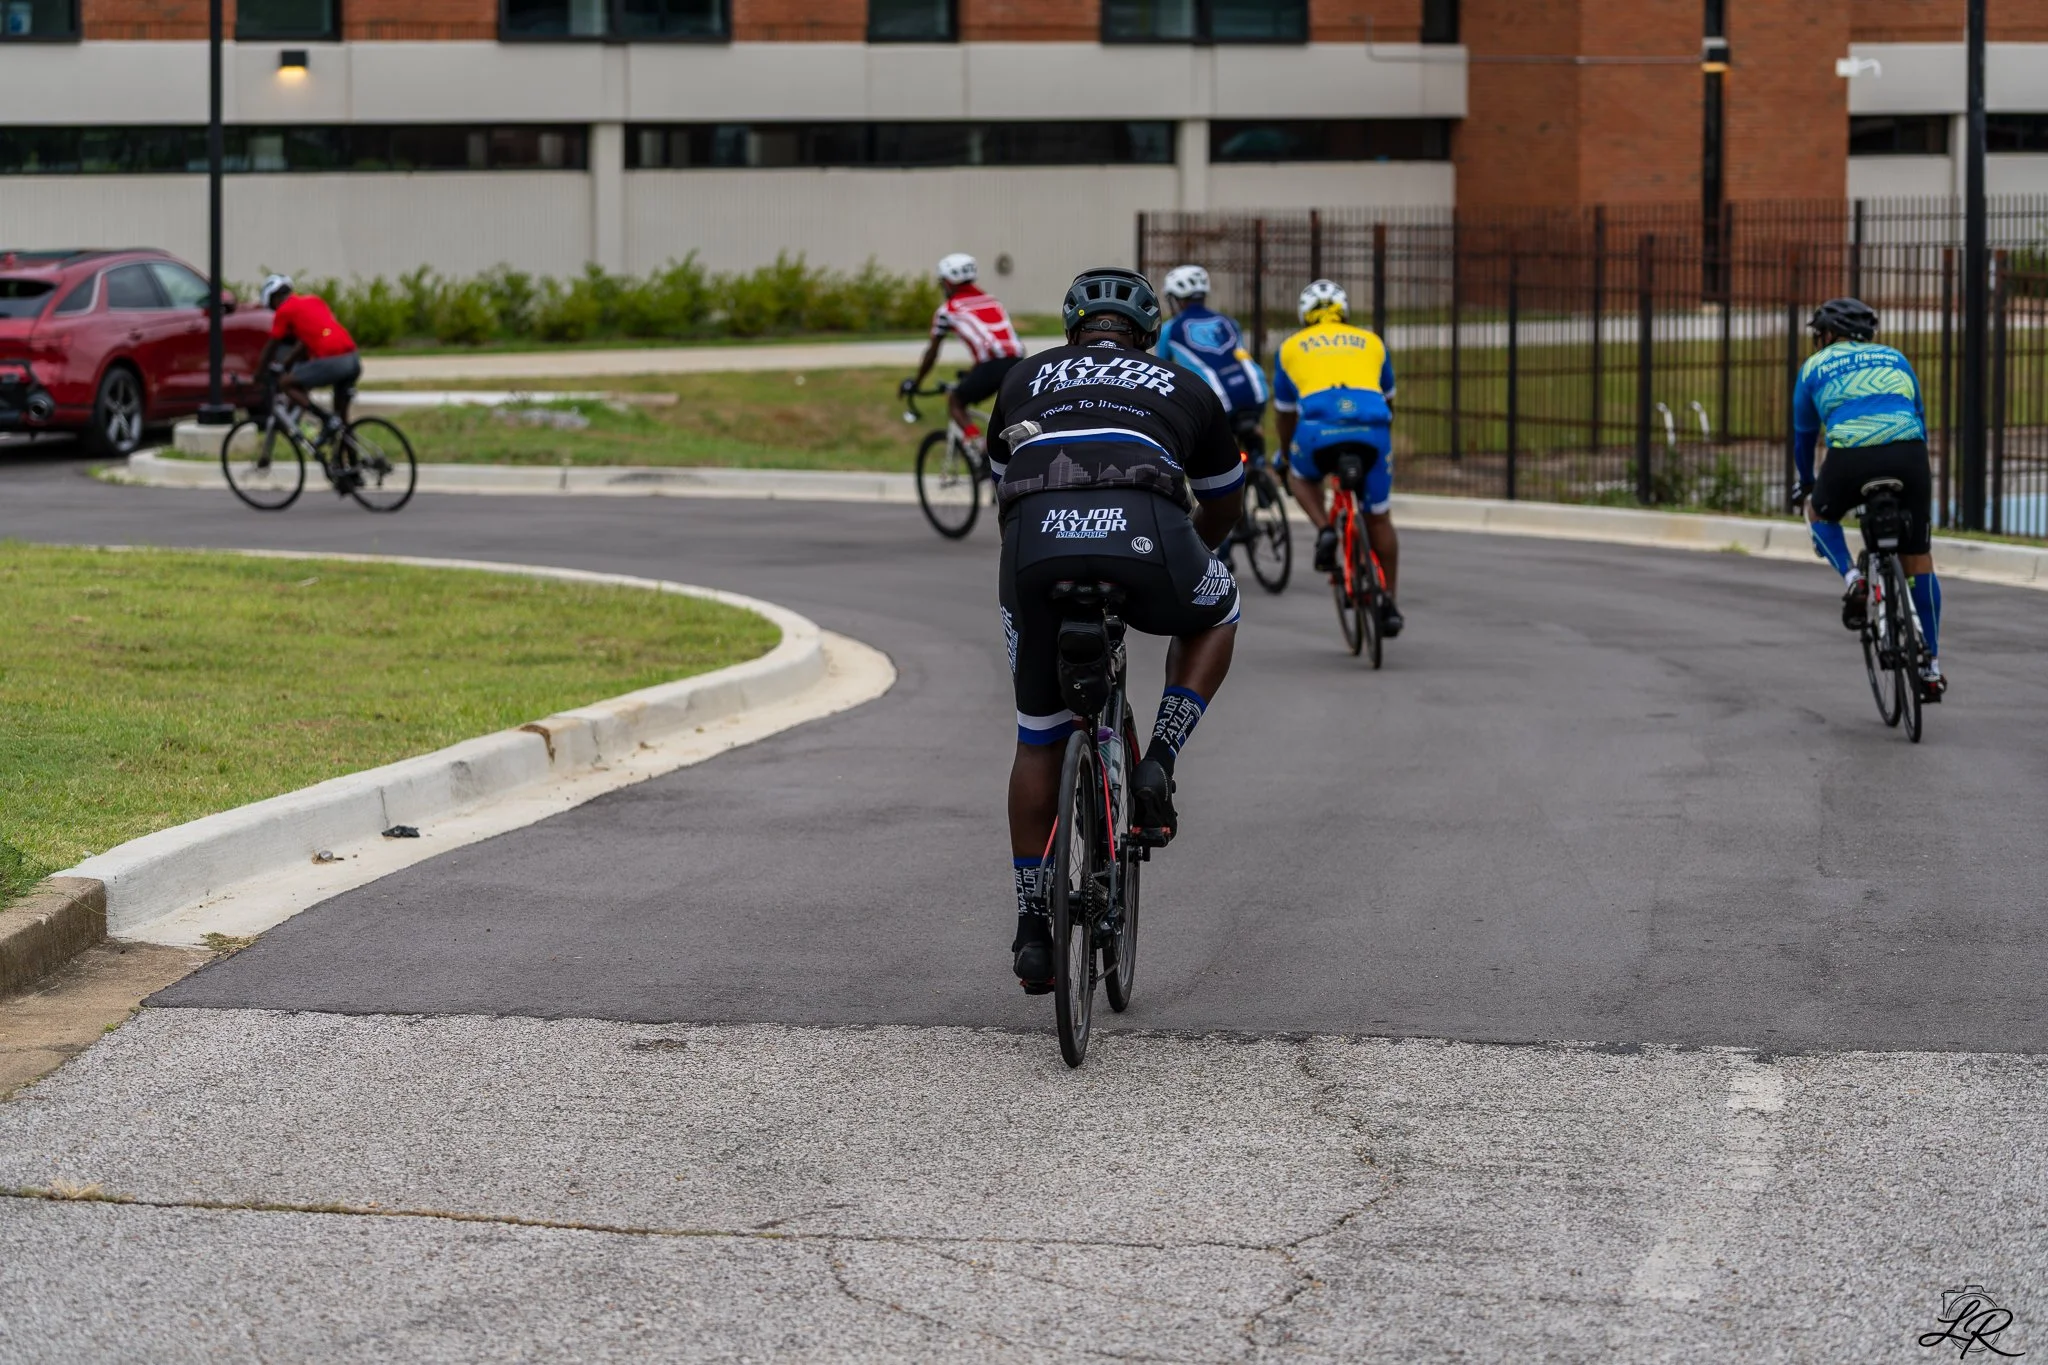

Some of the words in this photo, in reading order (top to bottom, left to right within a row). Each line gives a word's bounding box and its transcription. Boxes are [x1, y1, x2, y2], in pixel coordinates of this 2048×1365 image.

[1036, 356, 1176, 383] MAJOR
[1028, 366, 1176, 397] TAYLOR
[1052, 377, 1138, 393] MEMPHIS
[1078, 399, 1094, 409] To
[1046, 508, 1123, 521] MAJOR
[1041, 519, 1127, 533] TAYLOR
[1055, 530, 1108, 539] MEMPHIS
[1193, 575, 1231, 596] TAYLOR
[1153, 695, 1181, 737] MAJOR
[1160, 698, 1194, 745] TAYLOR
